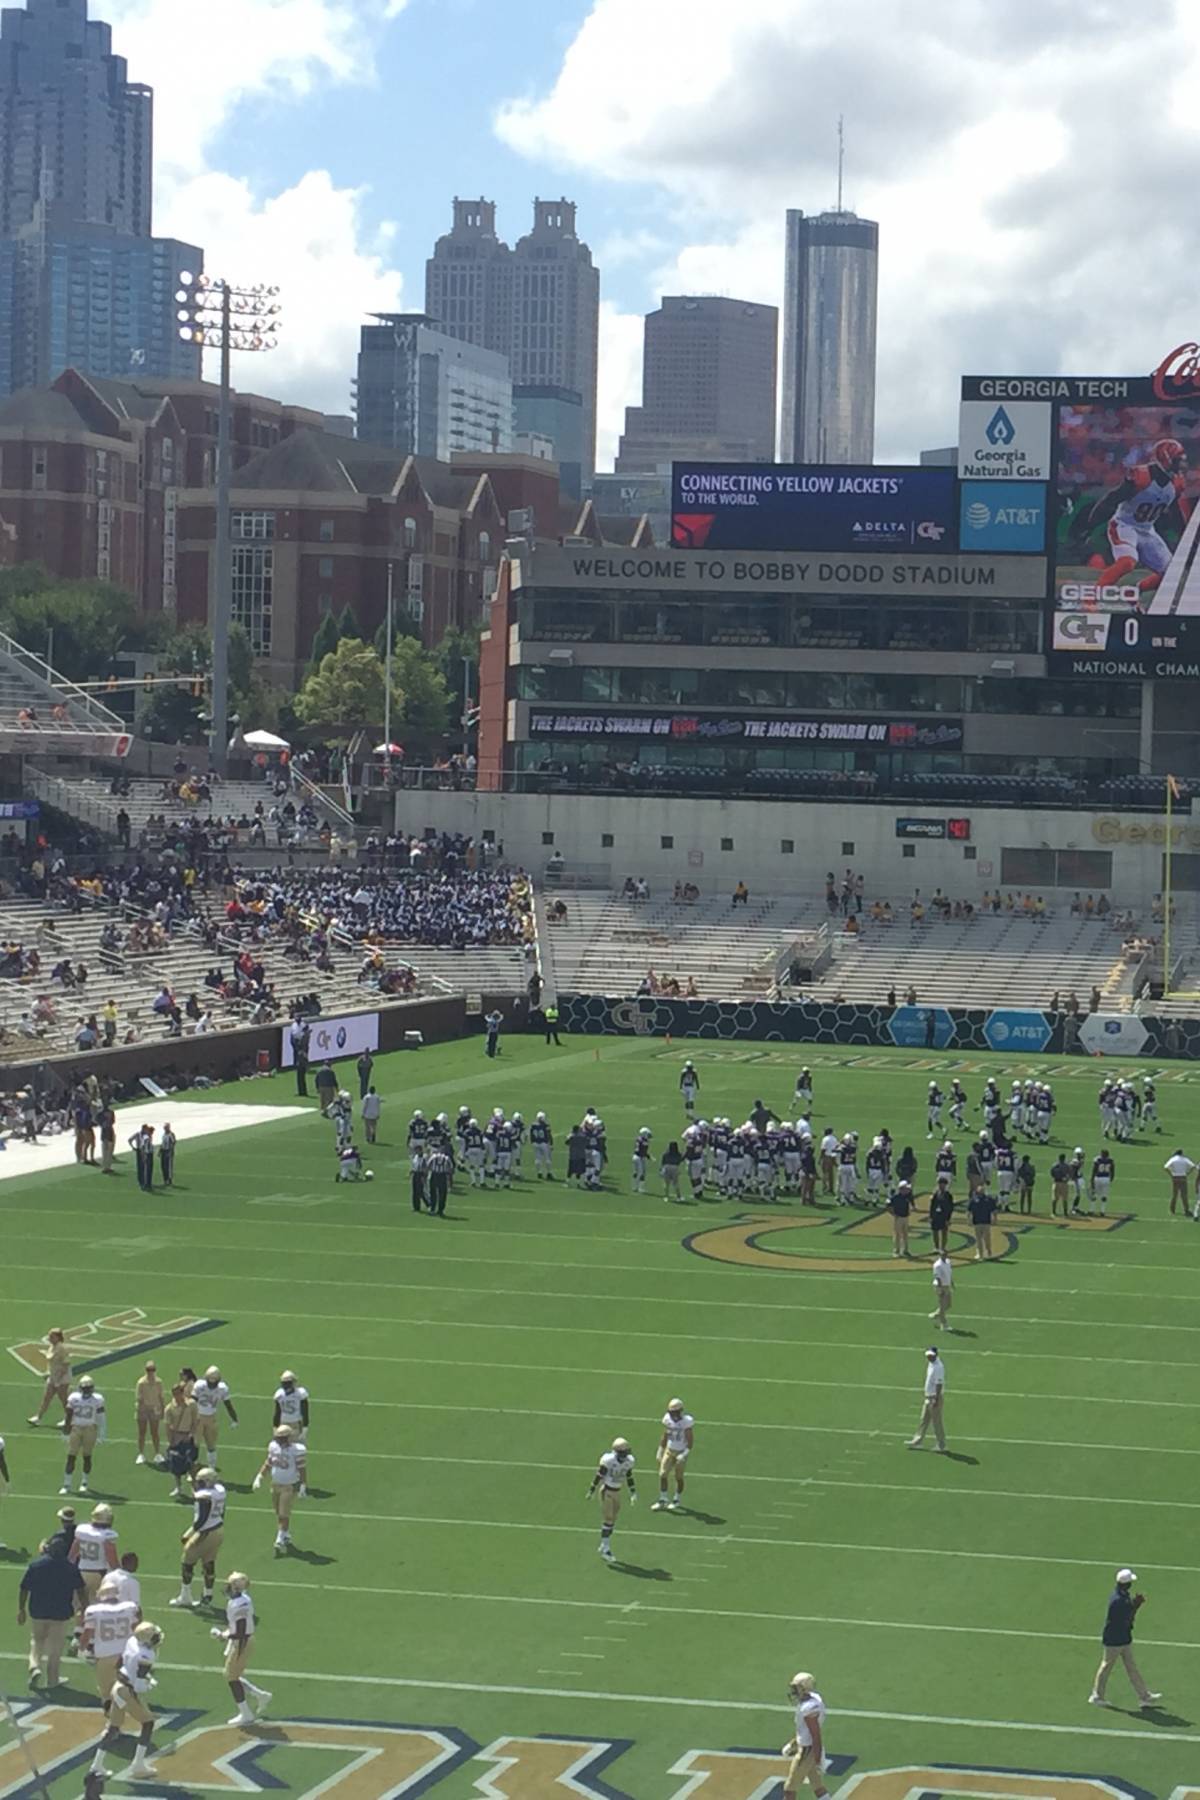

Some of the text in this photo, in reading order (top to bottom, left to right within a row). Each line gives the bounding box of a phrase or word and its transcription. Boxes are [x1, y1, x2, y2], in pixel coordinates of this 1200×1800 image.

[980, 380, 1128, 397] GEORGIA TECH
[974, 449, 1026, 465] Georgia
[963, 464, 1040, 477] Natural Gas
[681, 474, 772, 492] CONNECTING
[776, 476, 834, 493] YELLOW
[681, 492, 695, 504] TO
[698, 493, 718, 504] THE
[994, 508, 1040, 525] AT&T
[865, 521, 906, 532] DELTA
[573, 559, 995, 585] WELCOME TO BOBBY DODD STADIUM
[1060, 584, 1140, 601] GEICO
[1060, 615, 1105, 644] GT
[1124, 617, 1139, 646] 0
[1073, 661, 1146, 675] NATIONAL
[531, 715, 553, 731] THE
[553, 715, 604, 732] JACKETS
[604, 717, 652, 734] SWARM
[652, 718, 671, 734] ON
[744, 721, 766, 737] THE
[766, 721, 818, 739] JACKETS
[819, 723, 867, 740] SWARM
[868, 724, 887, 740] ON
[1011, 1027, 1045, 1039] AT&T
[99, 1617, 131, 1642] 63
